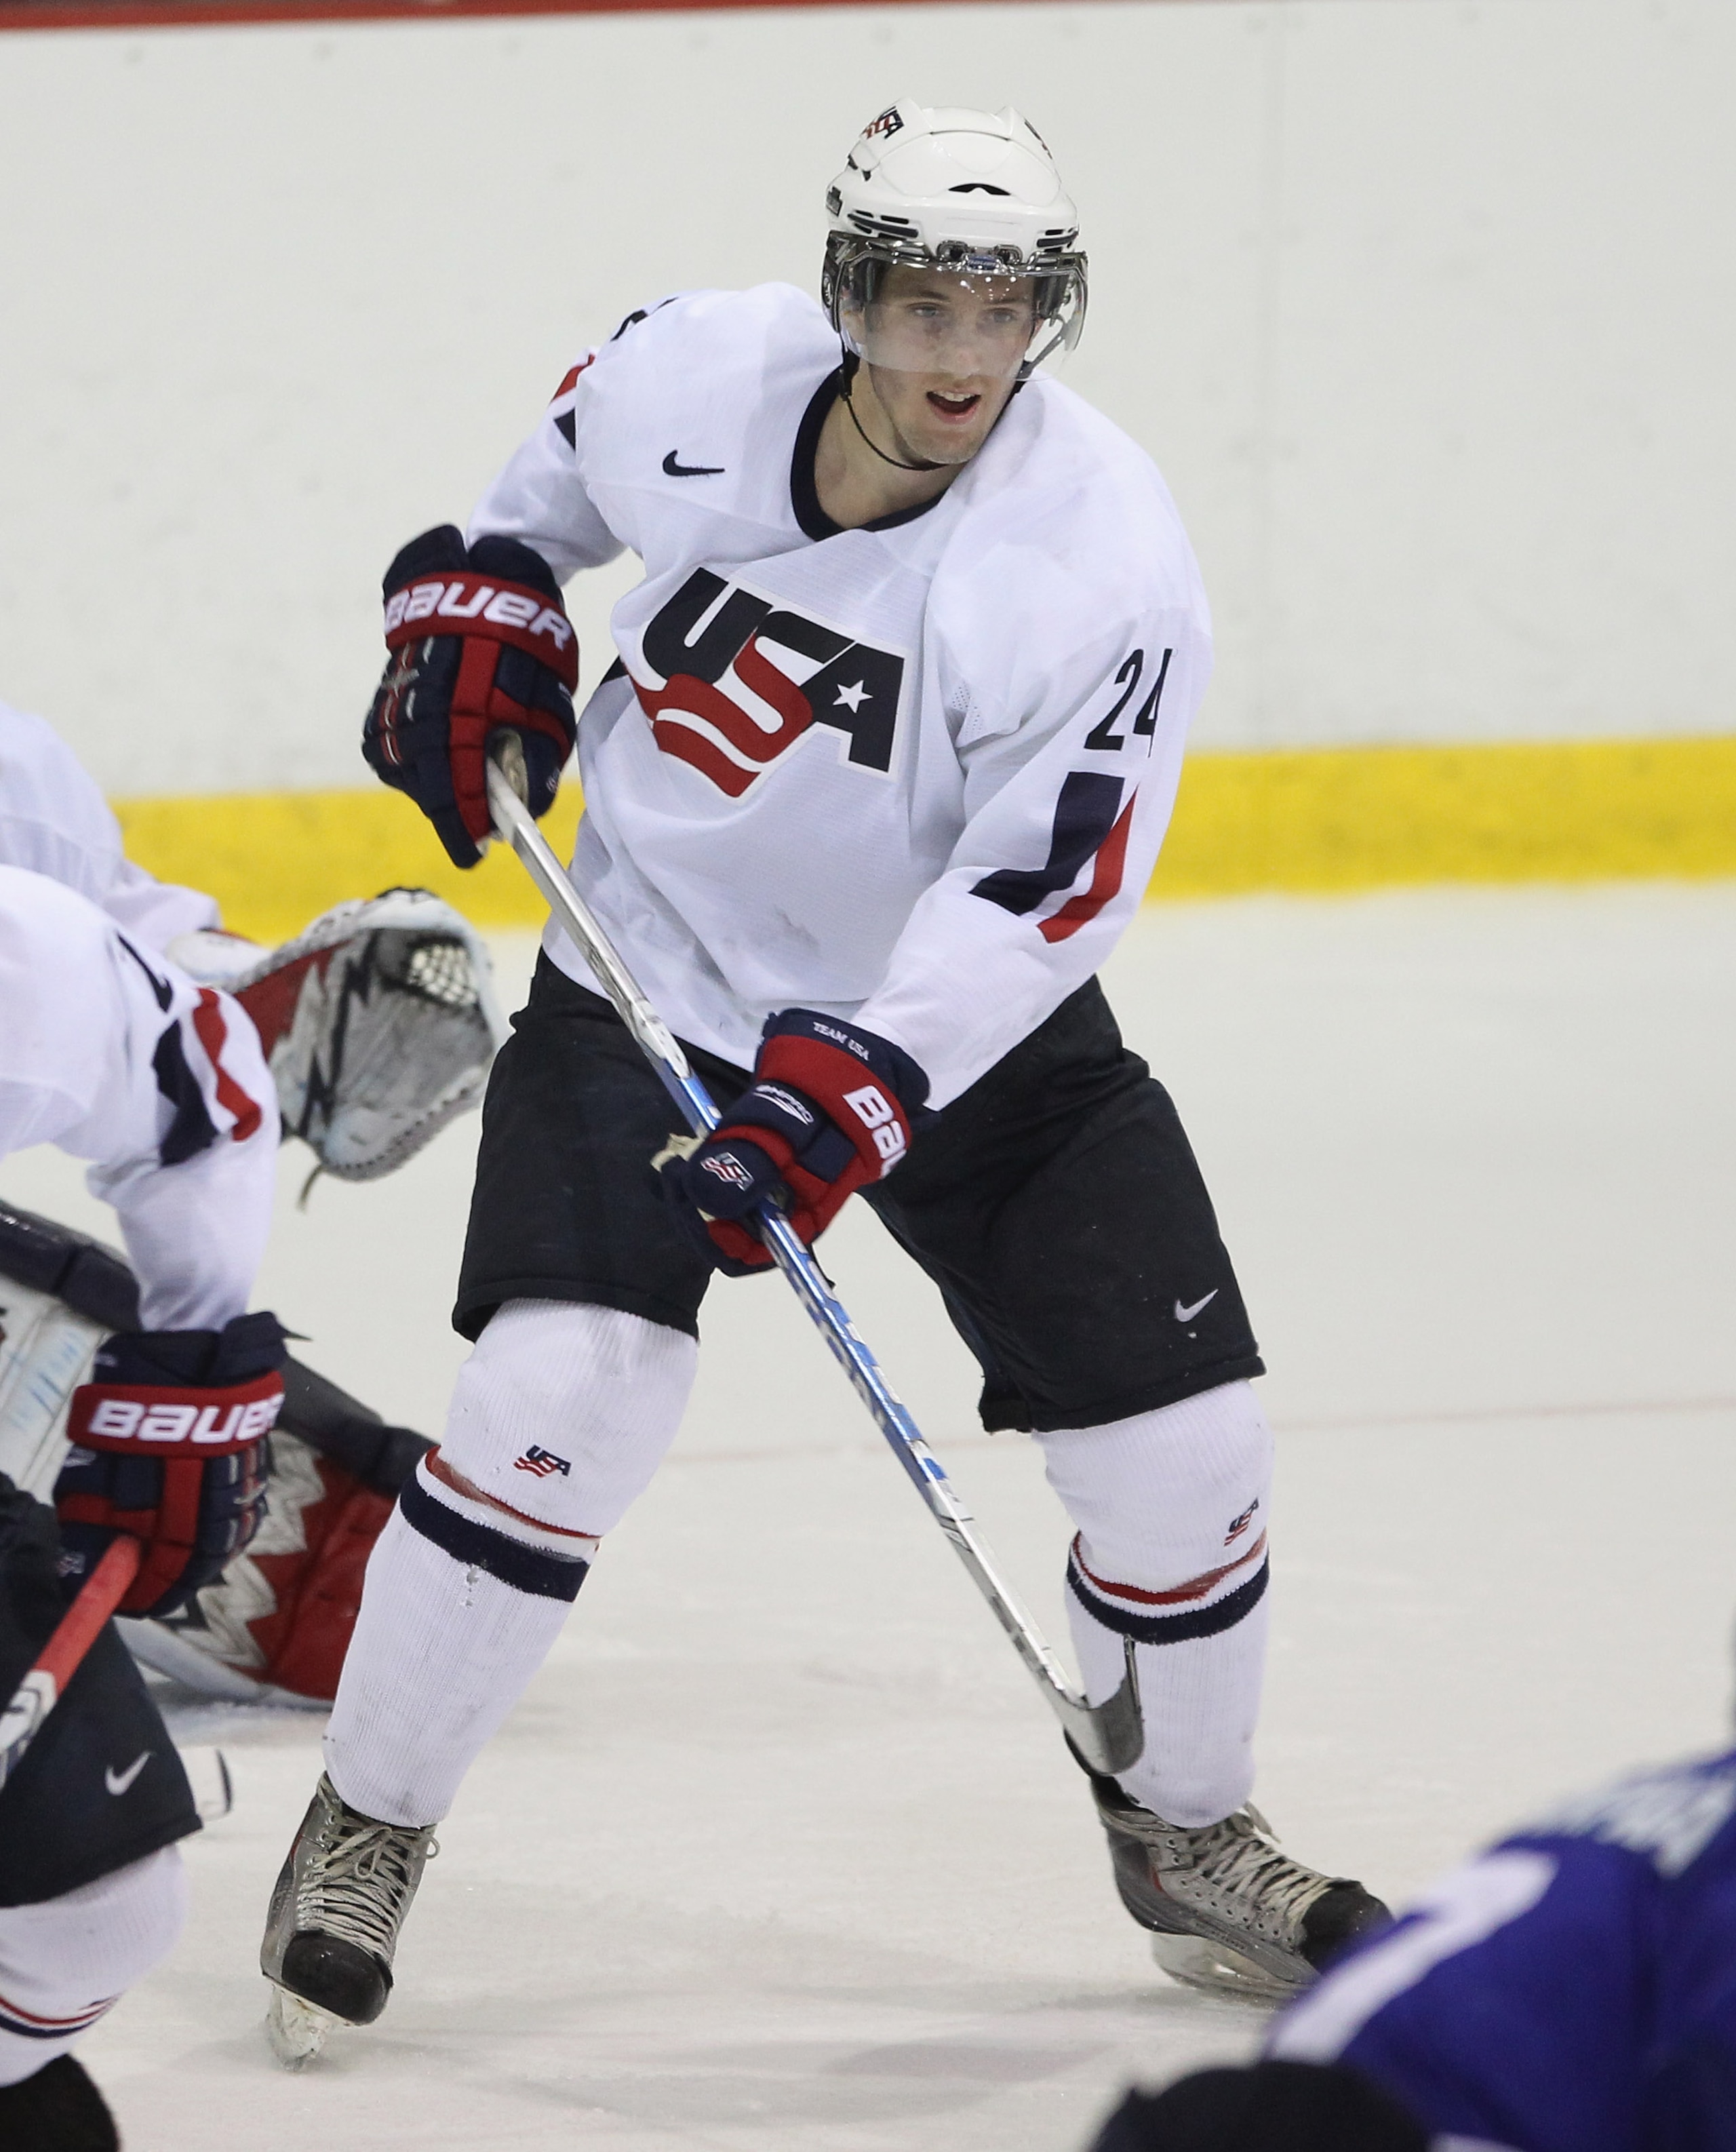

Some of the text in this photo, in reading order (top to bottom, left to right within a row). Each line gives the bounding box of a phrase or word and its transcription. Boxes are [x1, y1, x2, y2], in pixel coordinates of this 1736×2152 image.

[627, 567, 905, 798] USA
[1084, 648, 1172, 758] 24
[813, 1021, 869, 1061] TEAM USA
[513, 1444, 572, 1478] USA
